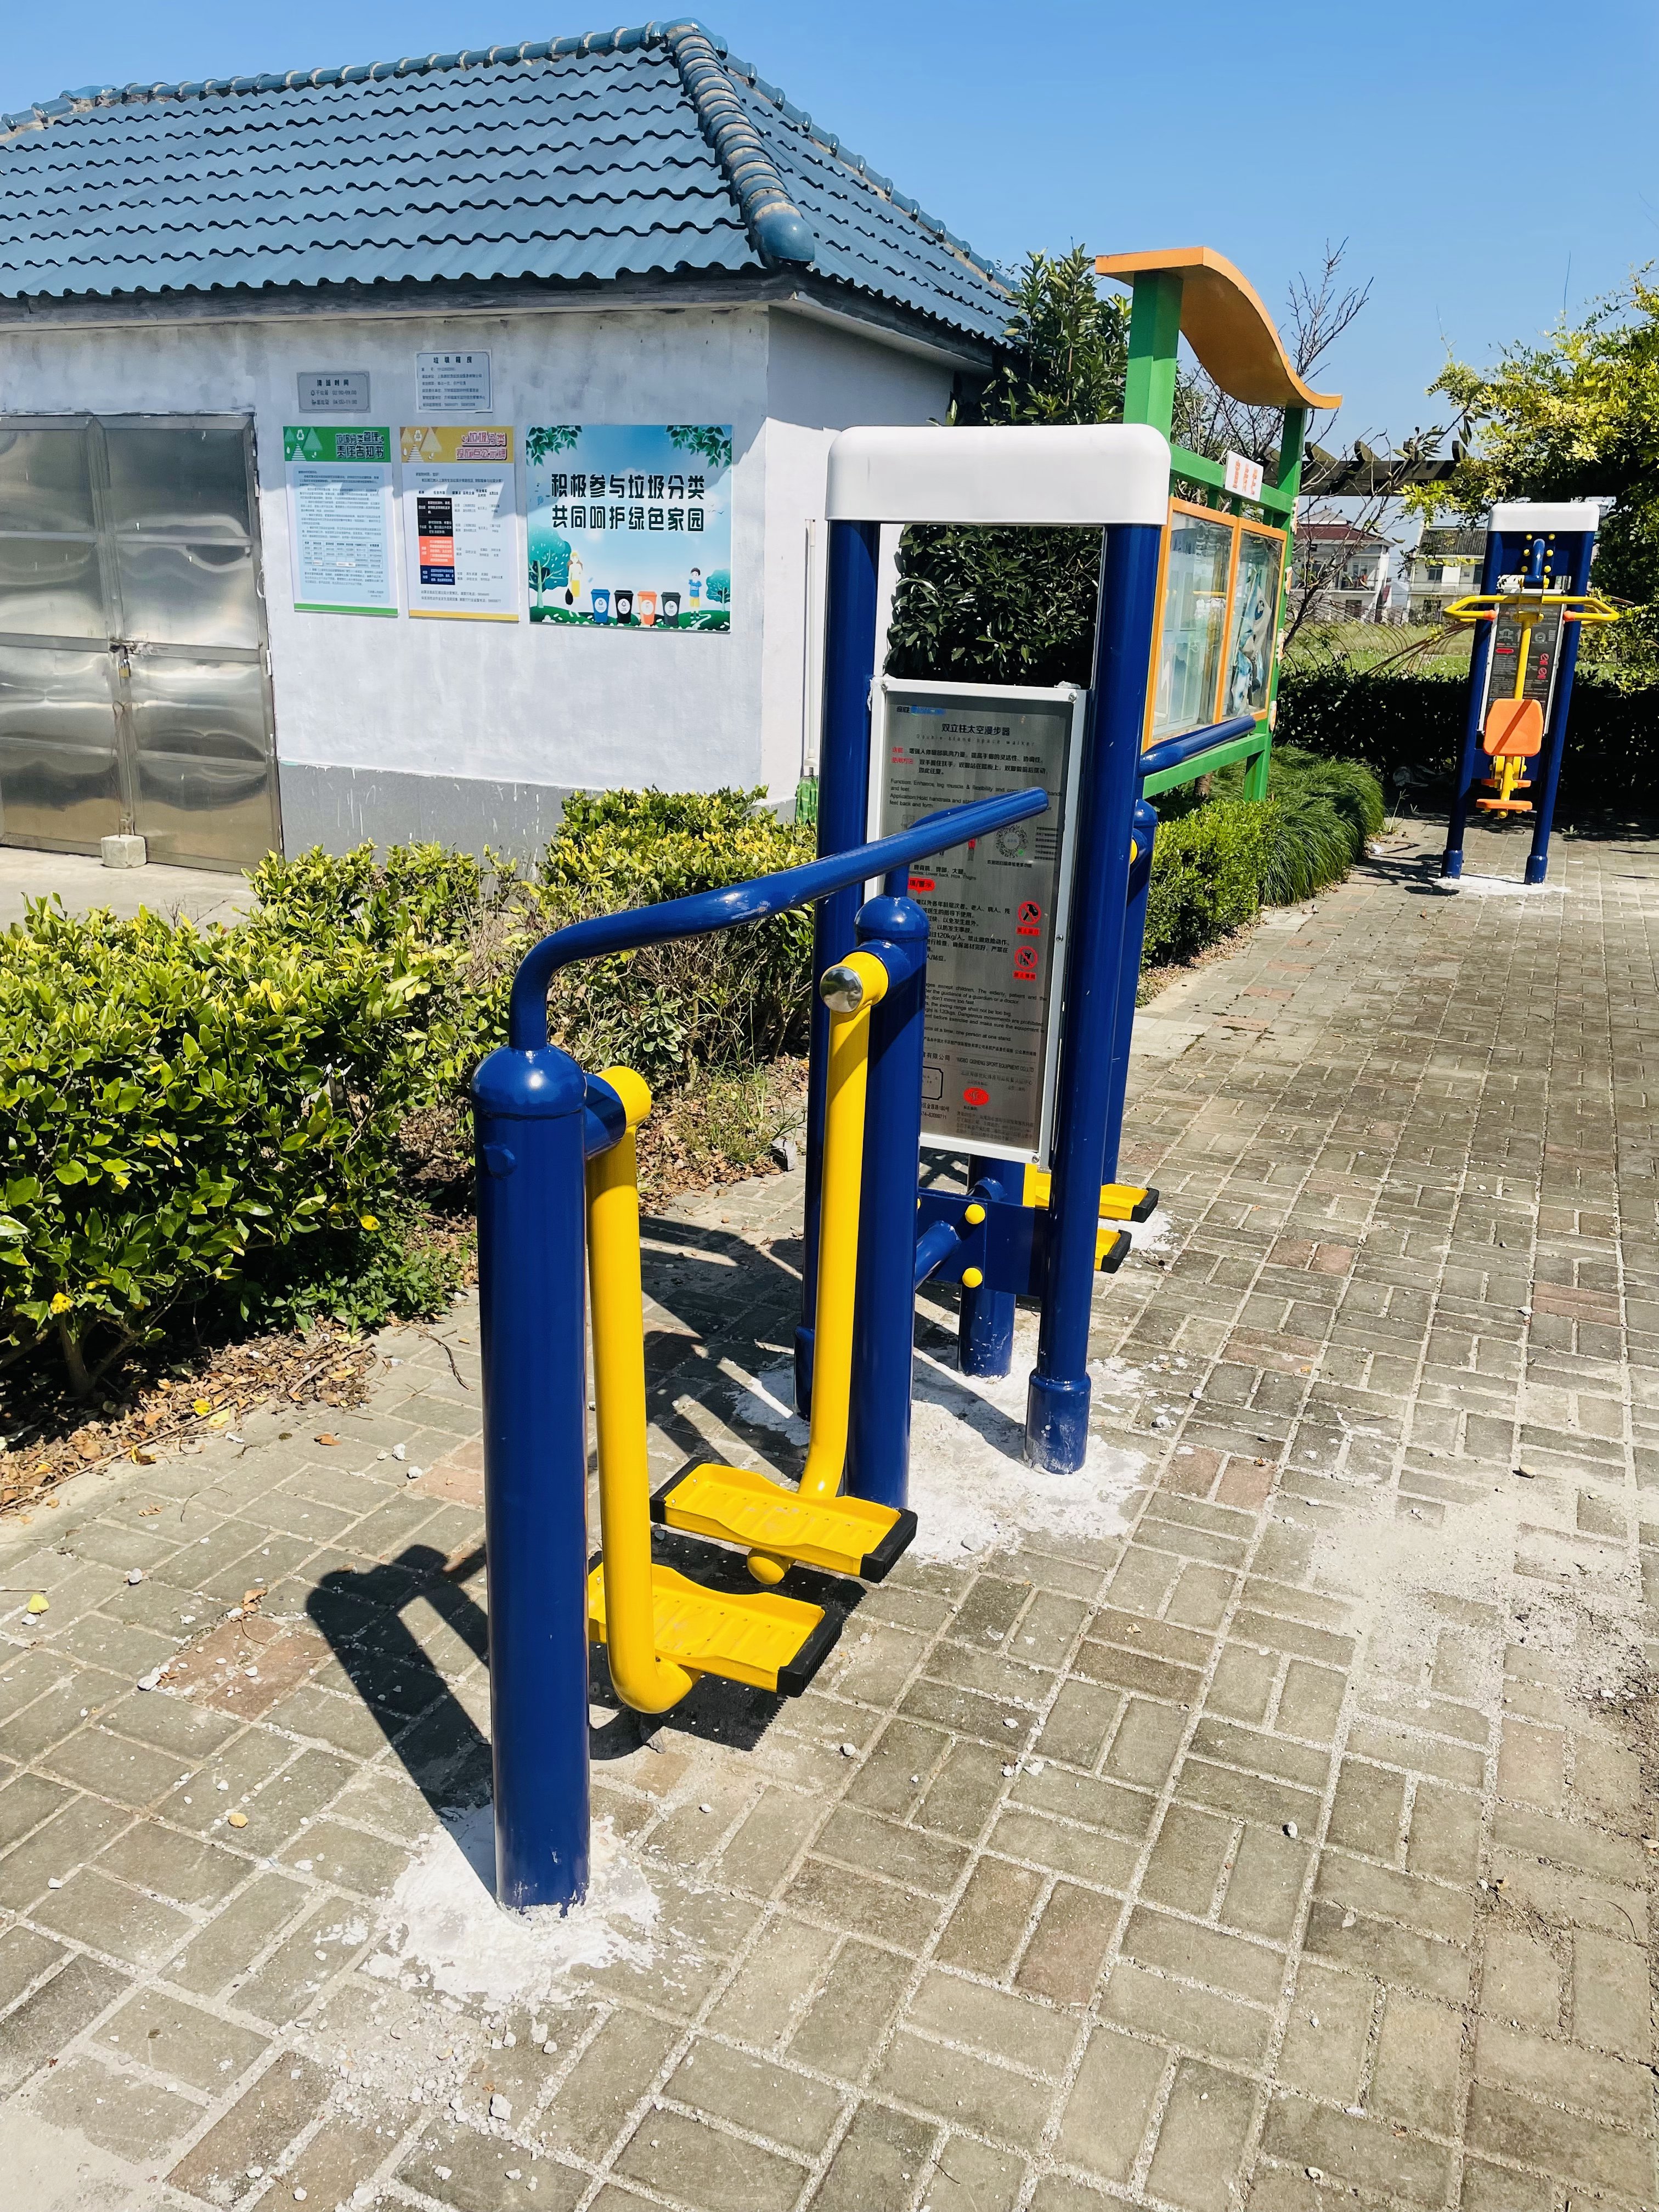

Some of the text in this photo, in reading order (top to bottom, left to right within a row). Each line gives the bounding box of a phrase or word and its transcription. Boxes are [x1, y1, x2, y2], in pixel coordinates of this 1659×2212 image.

[336, 431, 379, 444] 垃圾分类管理
[468, 431, 507, 446] 垃圾分类
[336, 445, 385, 459] 责任告知书
[551, 473, 704, 500] 积极参与垃圾分类
[552, 505, 704, 532] 共同呵护绿色家园
[941, 723, 1011, 736] 双立柱太空漫步器
